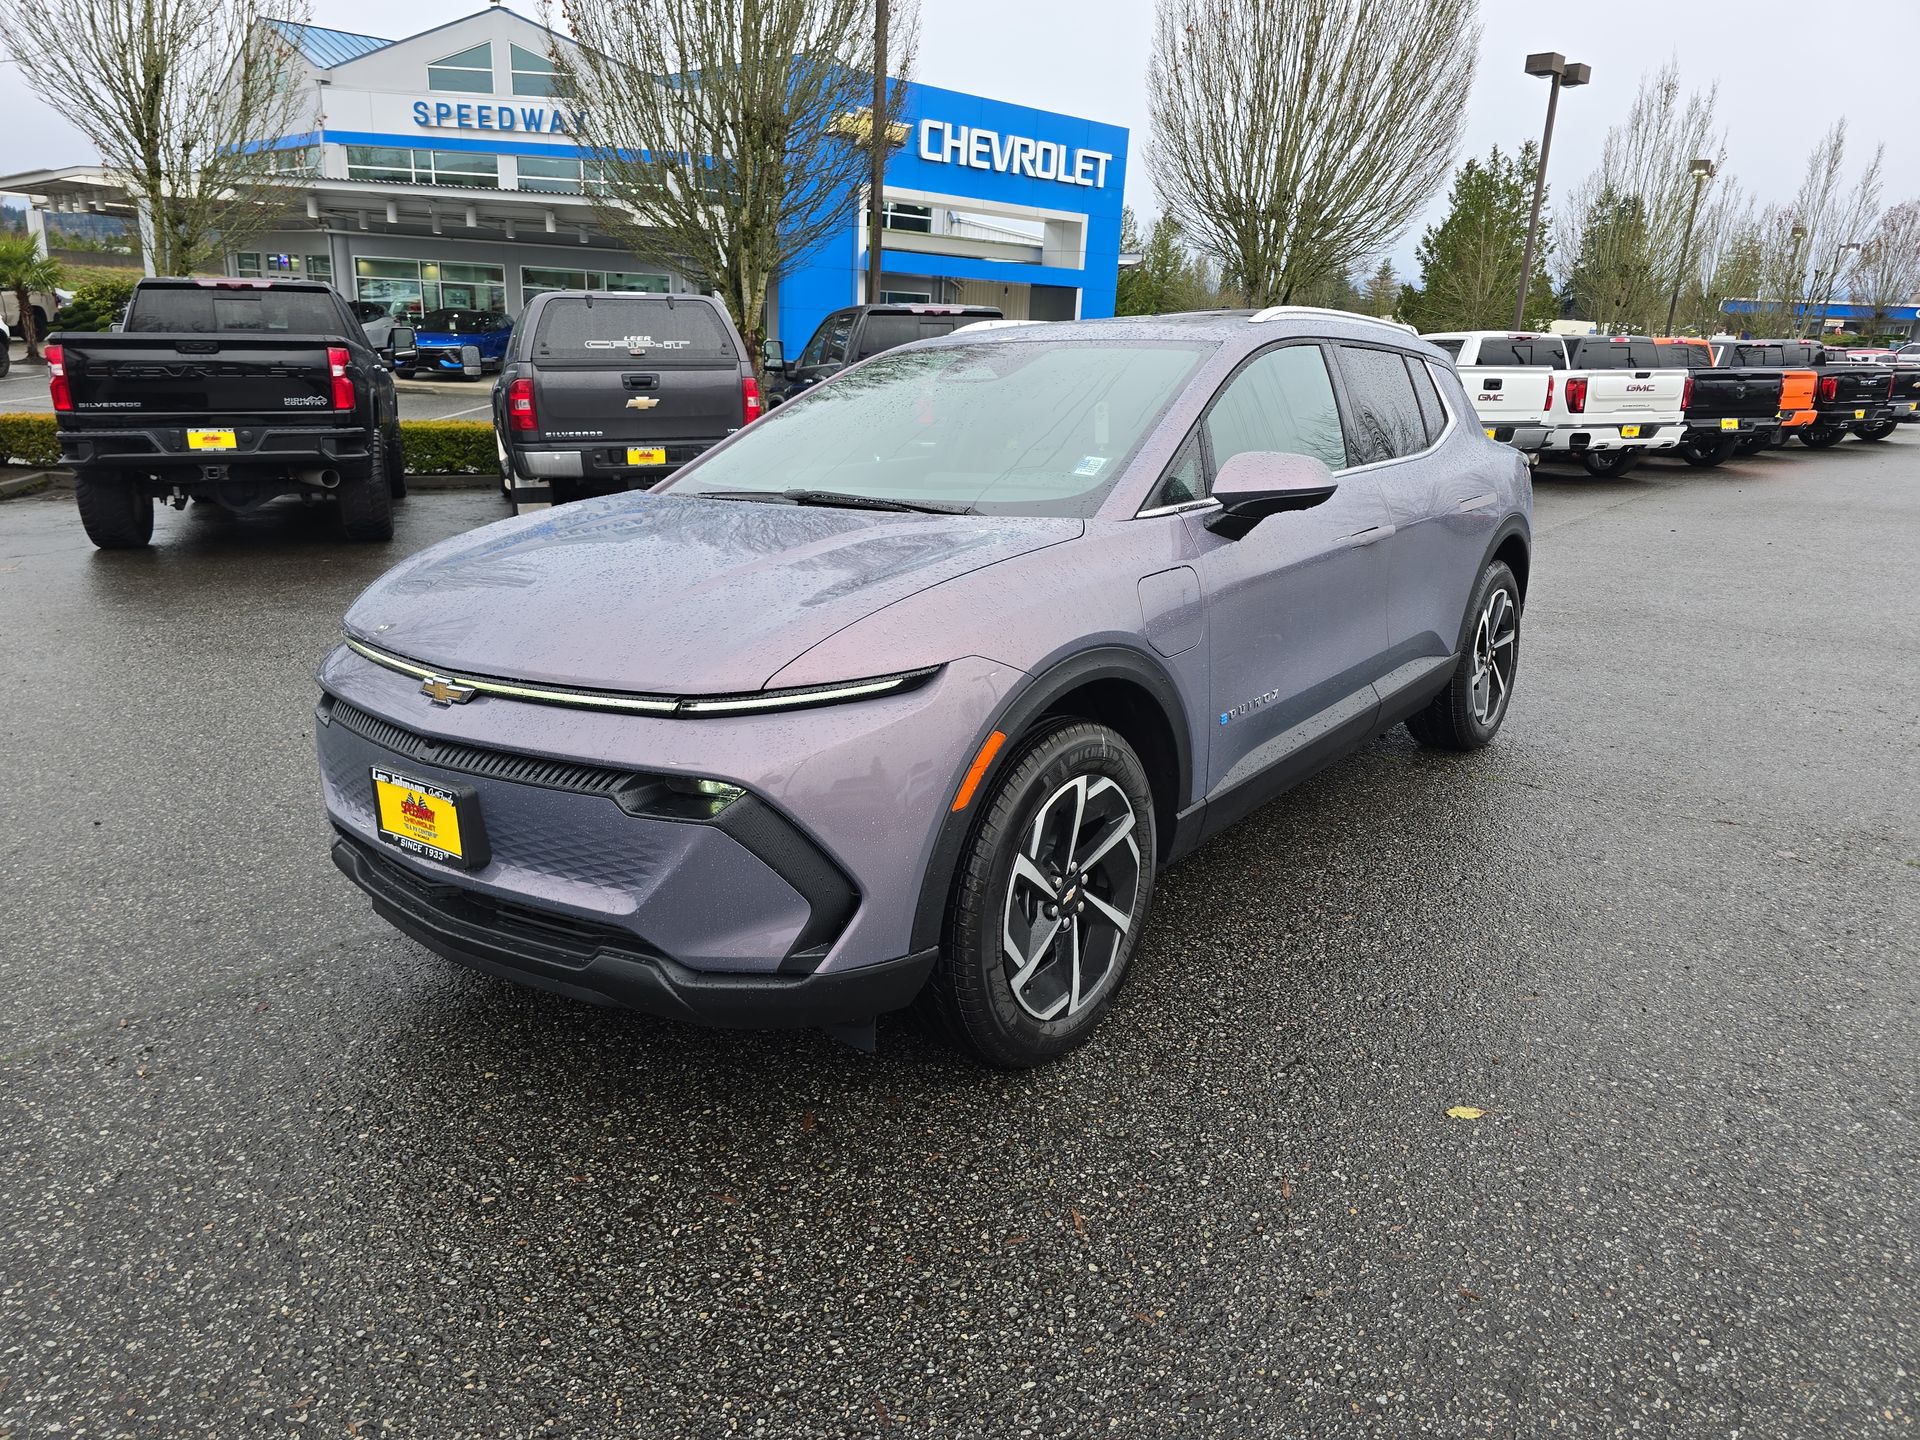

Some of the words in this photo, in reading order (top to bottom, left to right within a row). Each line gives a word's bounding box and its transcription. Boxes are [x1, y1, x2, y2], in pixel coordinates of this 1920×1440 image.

[413, 101, 587, 133] SPEEDWAY
[919, 118, 1113, 188] CHEVROLET
[1477, 393, 1505, 402] GMC
[1625, 384, 1656, 392] GMC
[1219, 688, 1279, 726] EQUINOX
[403, 815, 436, 832] CHEVROLET
[400, 838, 422, 853] SINCE
[425, 847, 444, 860] 1933
